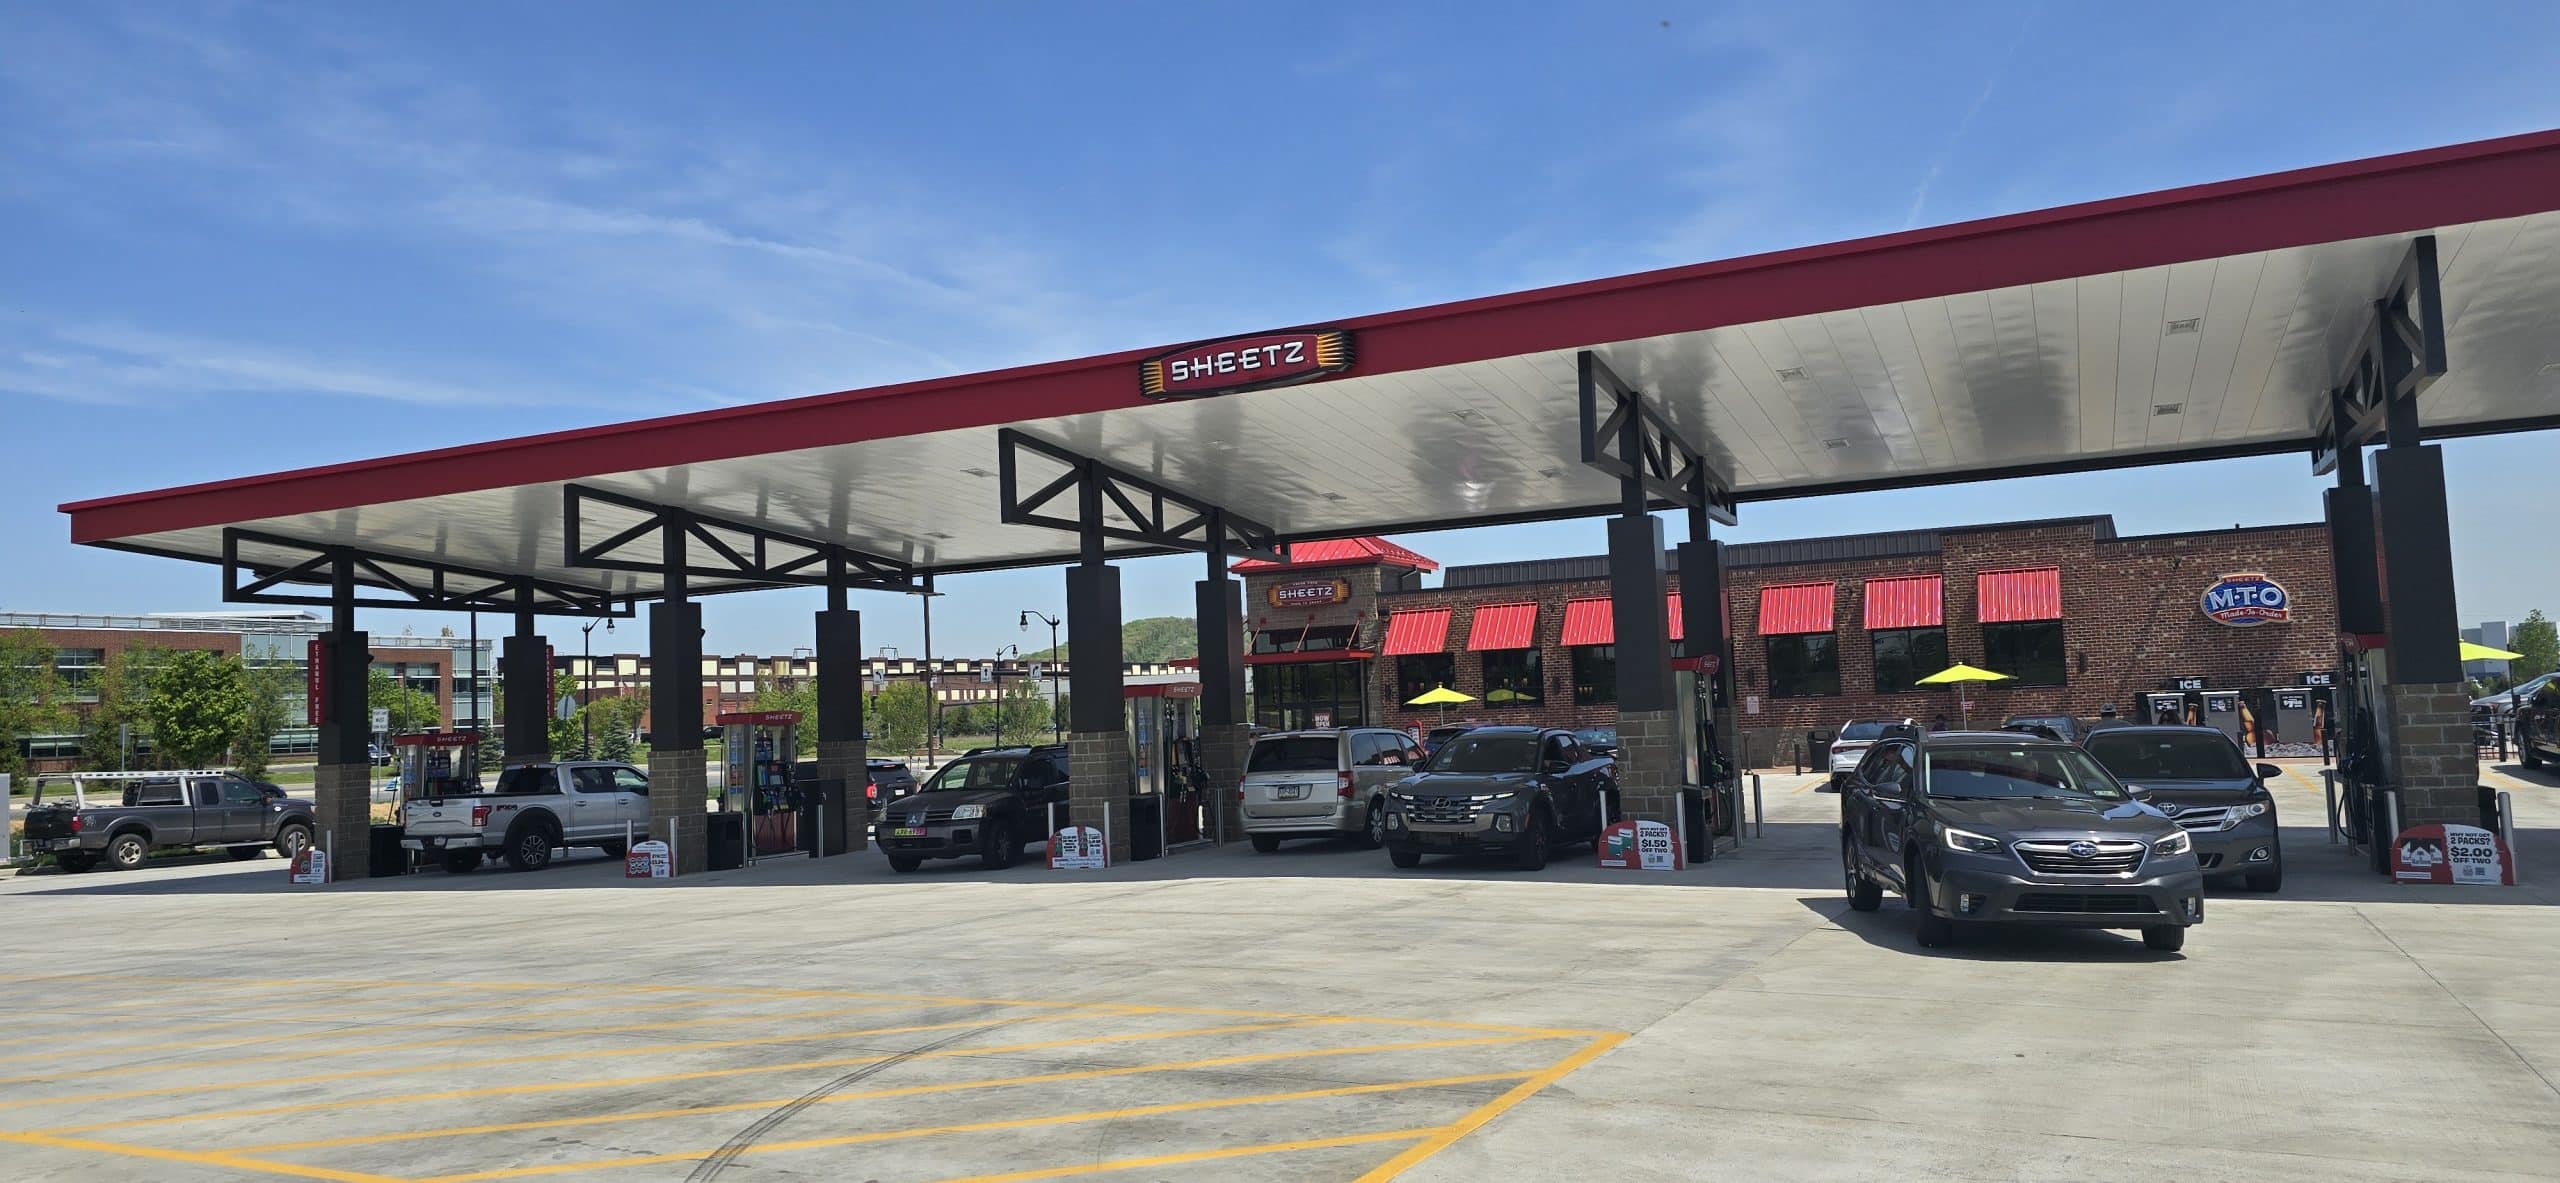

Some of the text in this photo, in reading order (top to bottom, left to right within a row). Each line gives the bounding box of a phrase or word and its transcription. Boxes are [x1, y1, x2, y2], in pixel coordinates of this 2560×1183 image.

[1171, 341, 1304, 382] SHEETZ
[1279, 586, 1333, 599] SHEETZ
[2179, 679, 2202, 689] ICE
[2306, 674, 2330, 685] ICE
[1641, 839, 1667, 847] $1.50
[2458, 837, 2490, 845] PACKS?
[2450, 846, 2492, 857] $2.00
